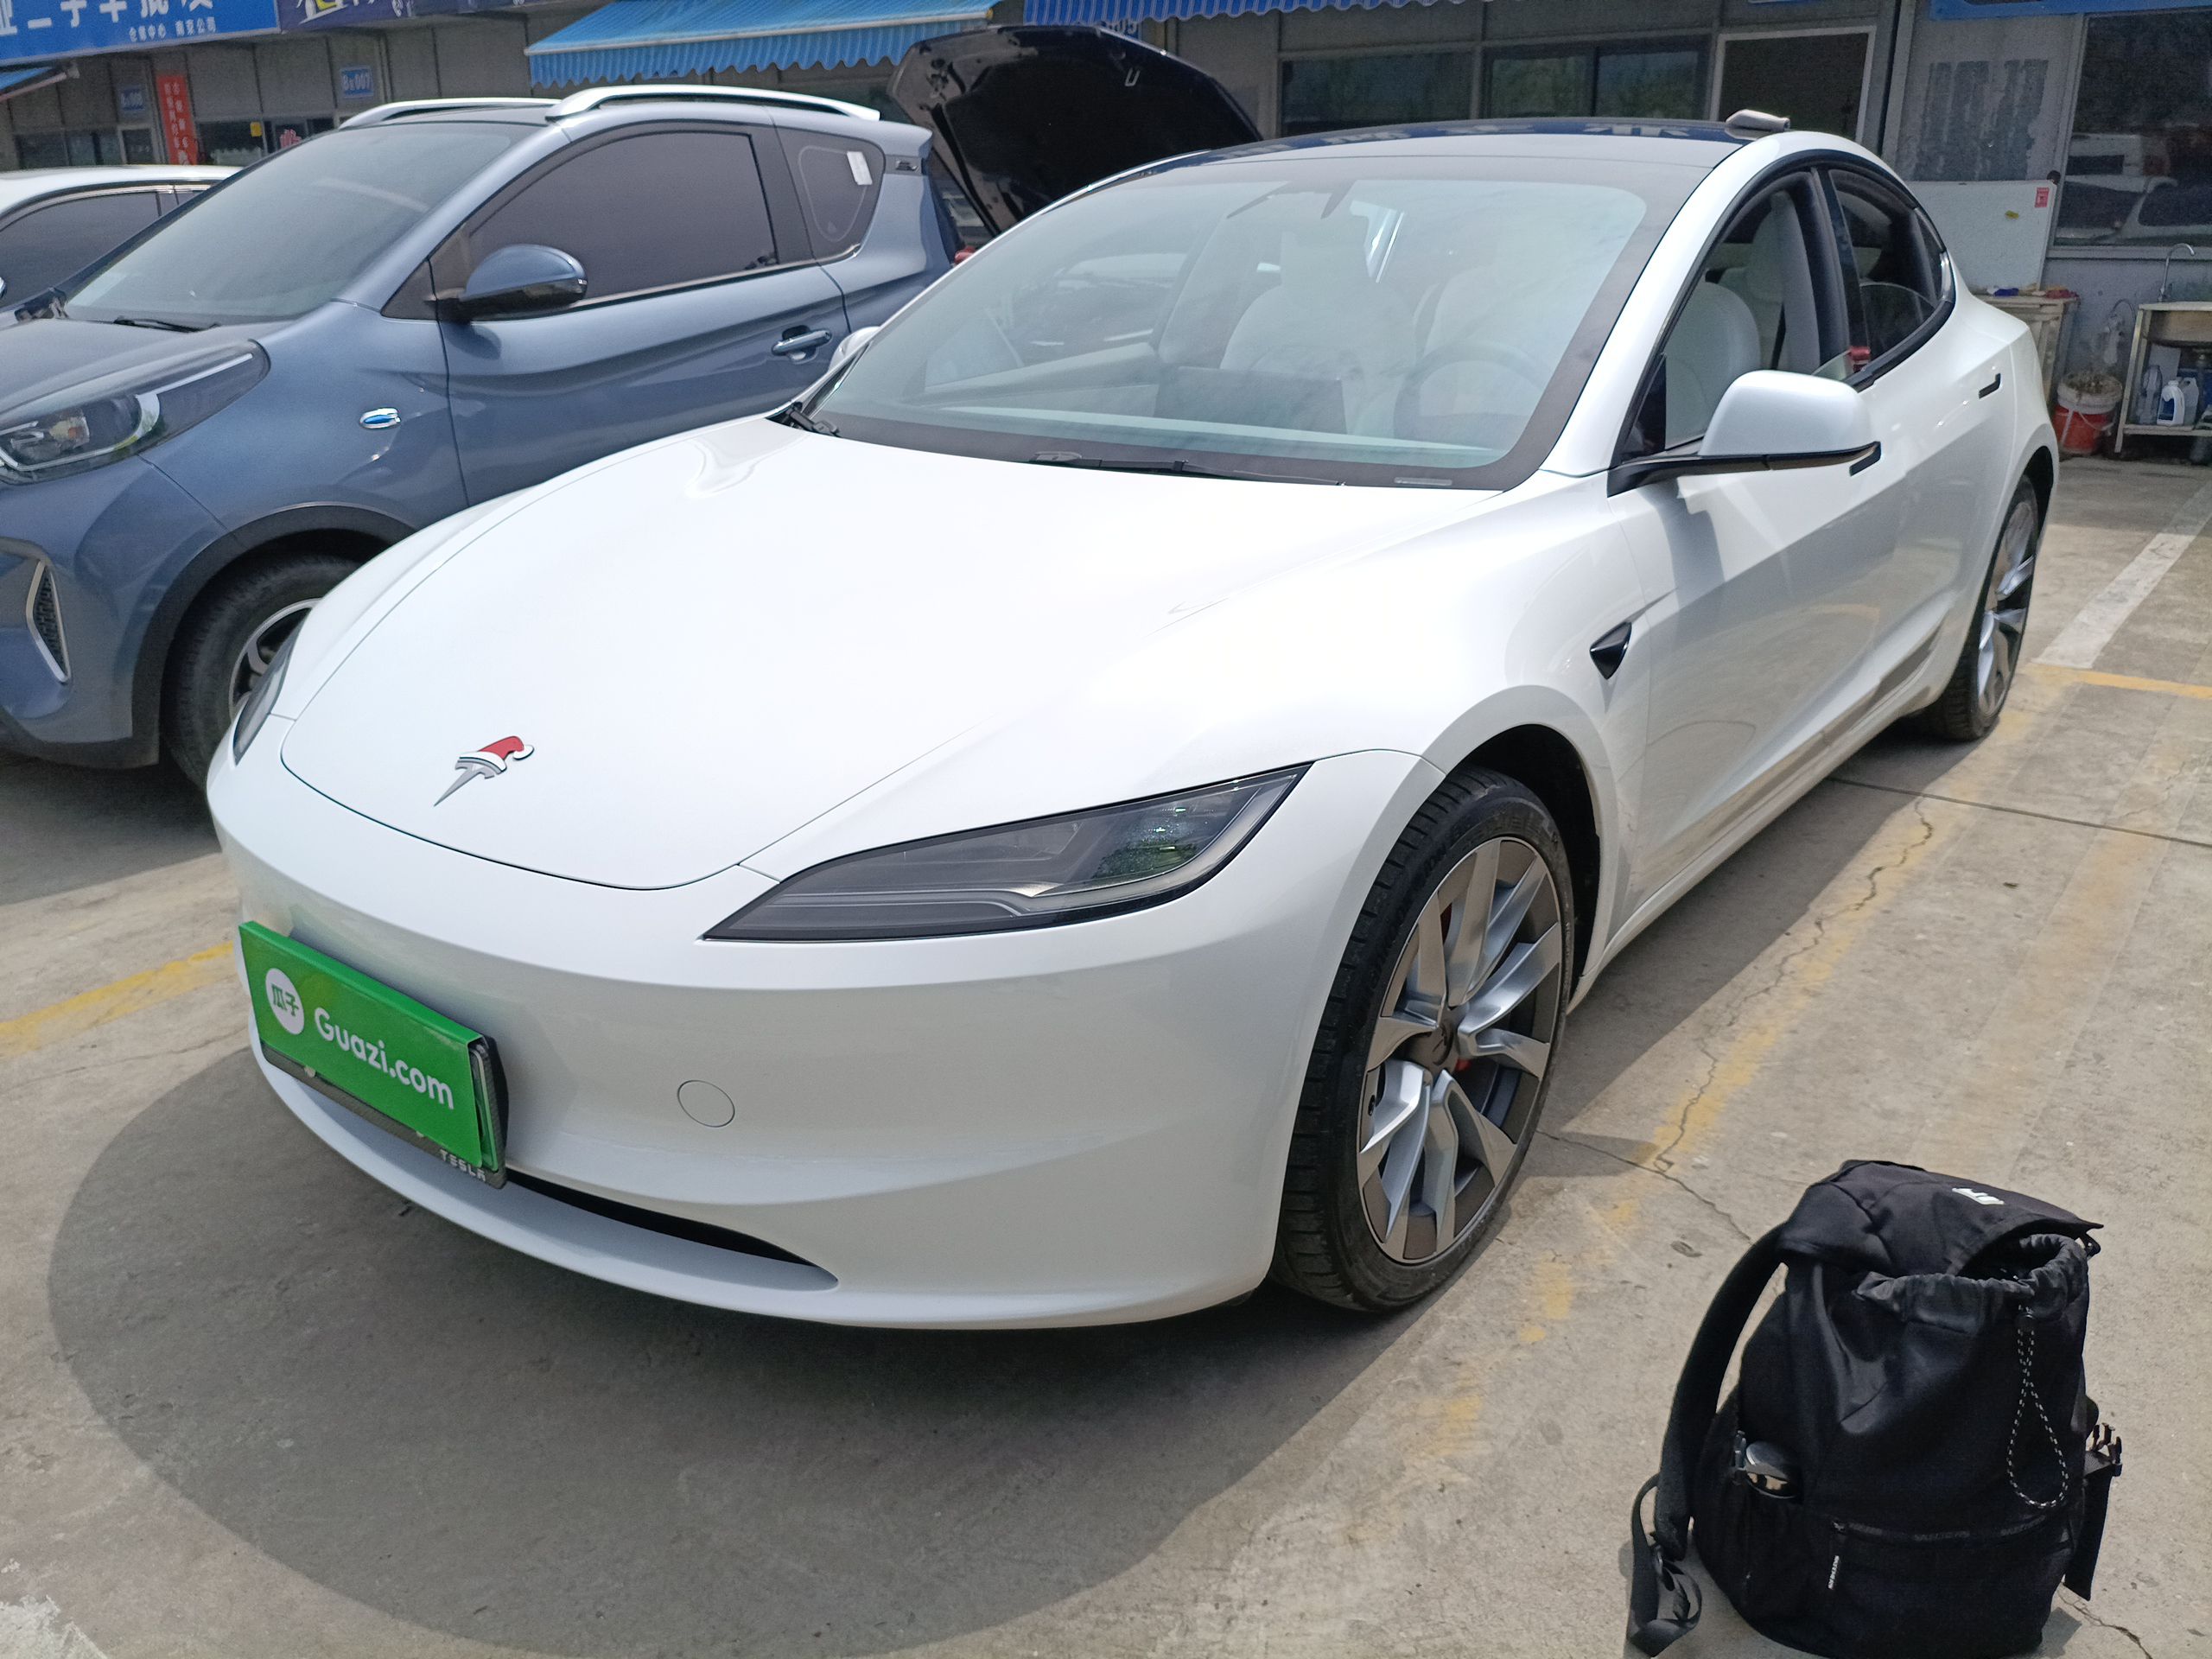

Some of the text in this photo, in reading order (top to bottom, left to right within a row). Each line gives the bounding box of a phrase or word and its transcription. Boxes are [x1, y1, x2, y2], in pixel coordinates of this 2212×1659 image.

[270, 983, 300, 1017] 瓜子
[314, 1007, 454, 1110] Guazi.com
[439, 1148, 486, 1182] TESLA
